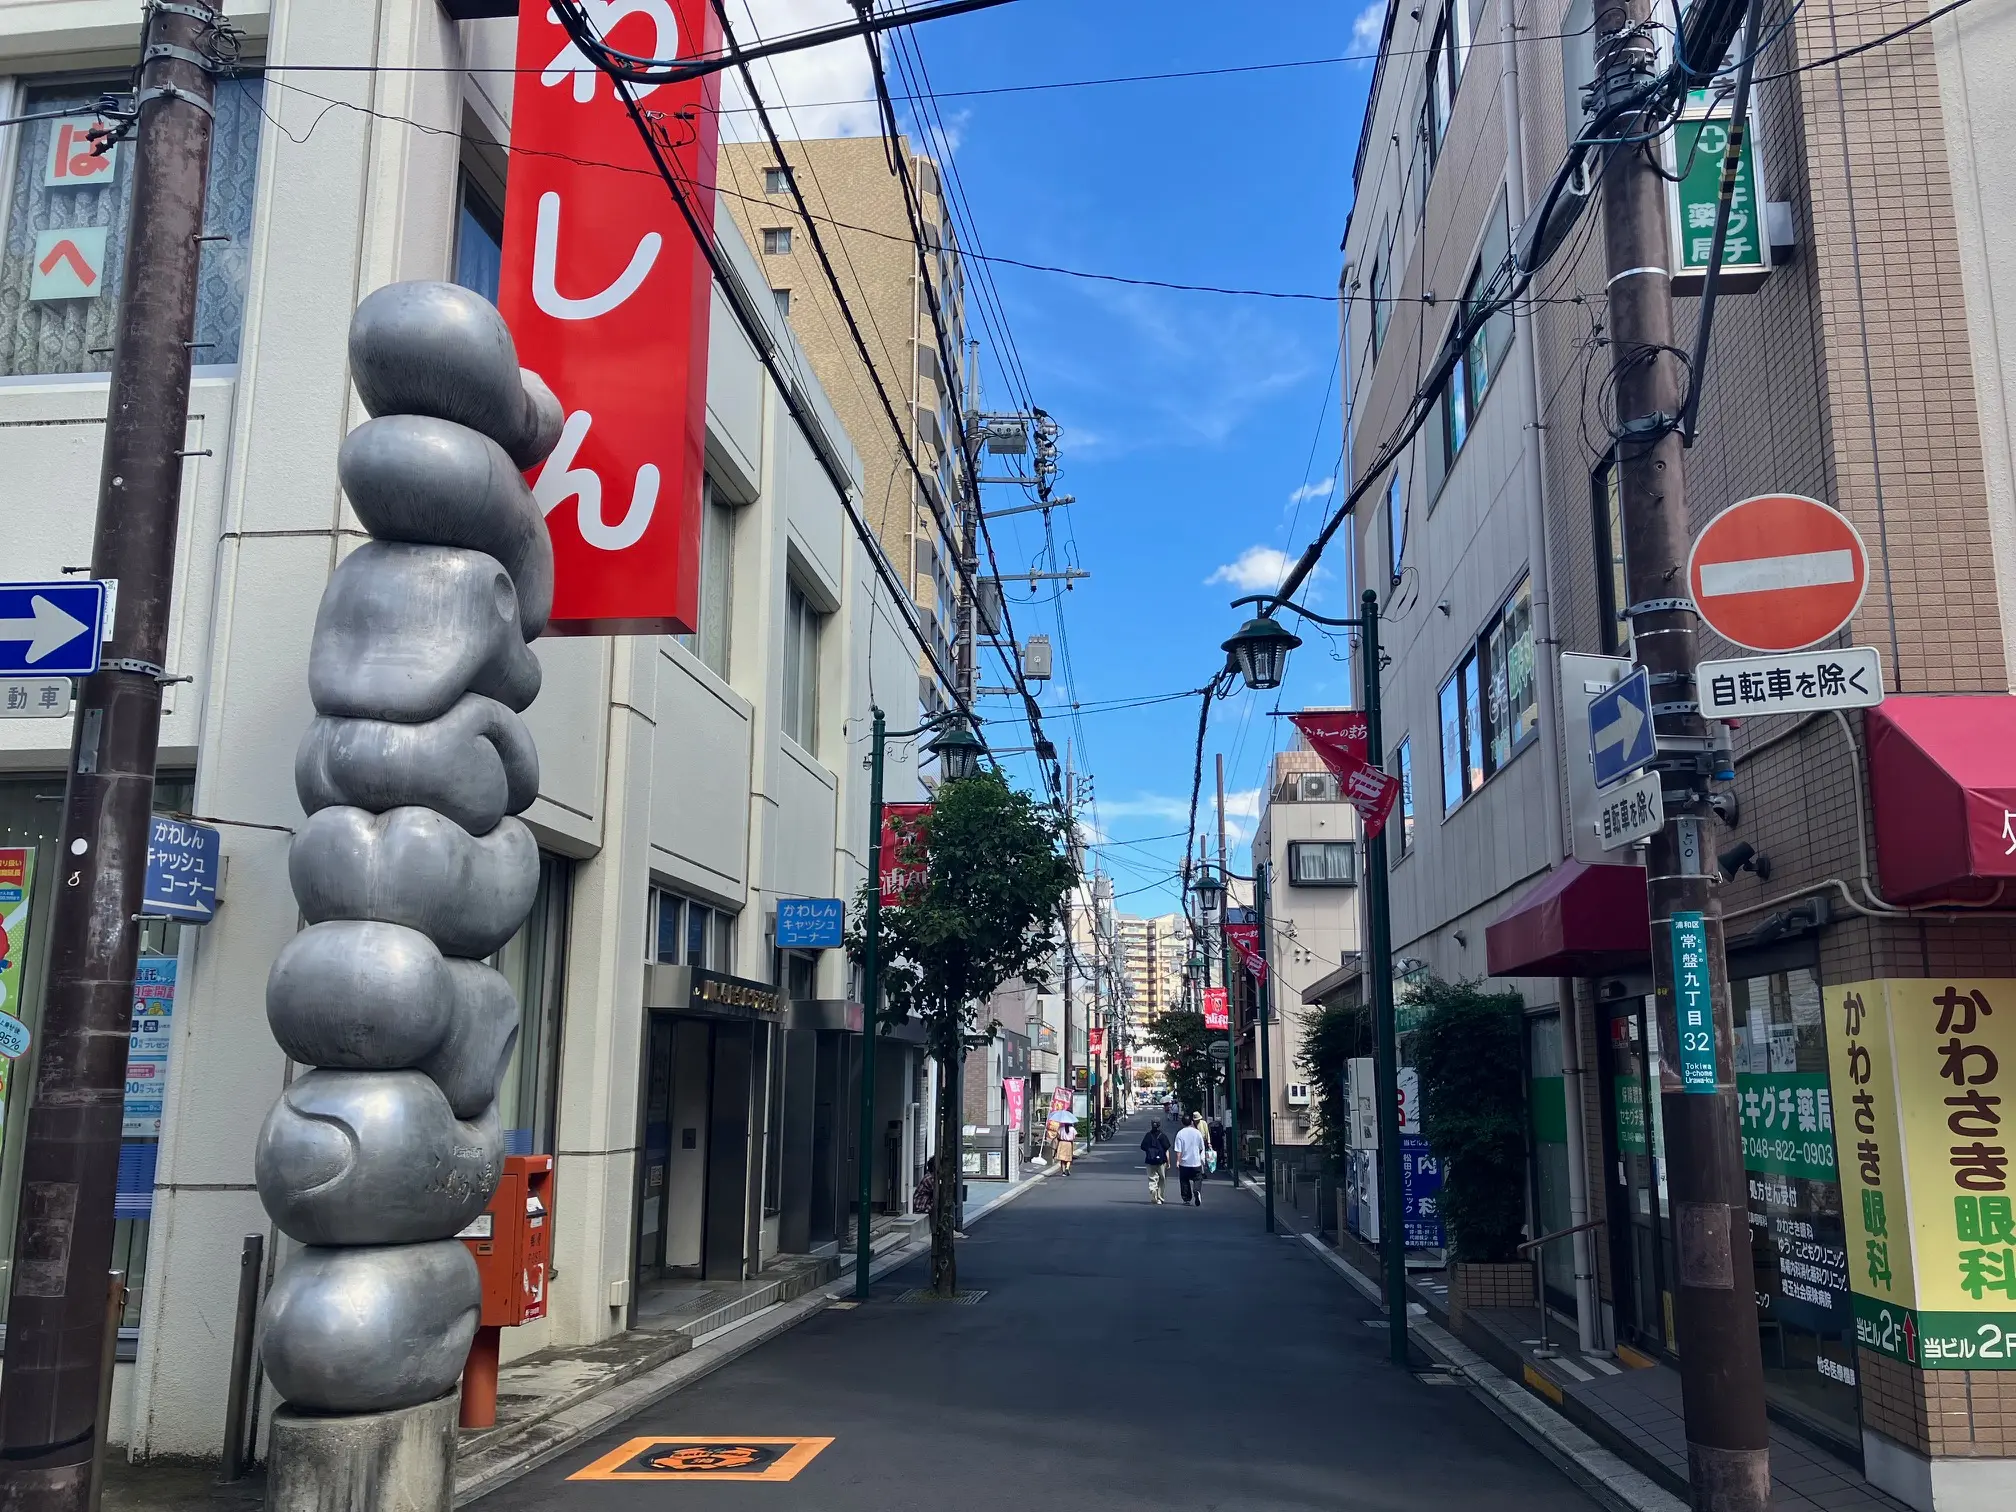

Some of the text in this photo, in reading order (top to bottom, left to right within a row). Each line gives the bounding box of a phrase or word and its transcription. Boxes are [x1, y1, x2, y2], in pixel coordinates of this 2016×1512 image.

[54, 122, 110, 178] は
[38, 239, 98, 288] へ
[1711, 662, 1870, 707] 自転車を除く
[1602, 789, 1657, 840] 自転車を除く
[153, 822, 205, 850] かわしん
[146, 847, 206, 874] キャッシュ
[160, 873, 215, 897] コーナー
[782, 919, 836, 931] キャッシュ
[783, 904, 838, 917] かわしん
[1674, 920, 1700, 929] 浦和区
[786, 932, 831, 943] コーナー
[1680, 934, 1702, 1026] 常盤九丁目
[1684, 1032, 1710, 1051] 32
[1685, 1062, 1712, 1070] Tokiwa
[1685, 1076, 1714, 1084] Urawa-ku
[1737, 1087, 1833, 1134] セキグチ薬局
[1749, 1136, 1834, 1167] 048-822-0903
[1843, 991, 1892, 1292] かわさき眼科
[1932, 986, 2016, 1300] かわさき眼科
[1403, 1153, 1414, 1214] 松田クリニック
[1749, 1180, 1798, 1208] 処方せん受付
[1776, 1217, 1814, 1241] かわさき眼科
[1777, 1237, 1845, 1269] ゆう・こどもクリニック
[1779, 1256, 1848, 1292] 馬場内科消化器科クリニッ
